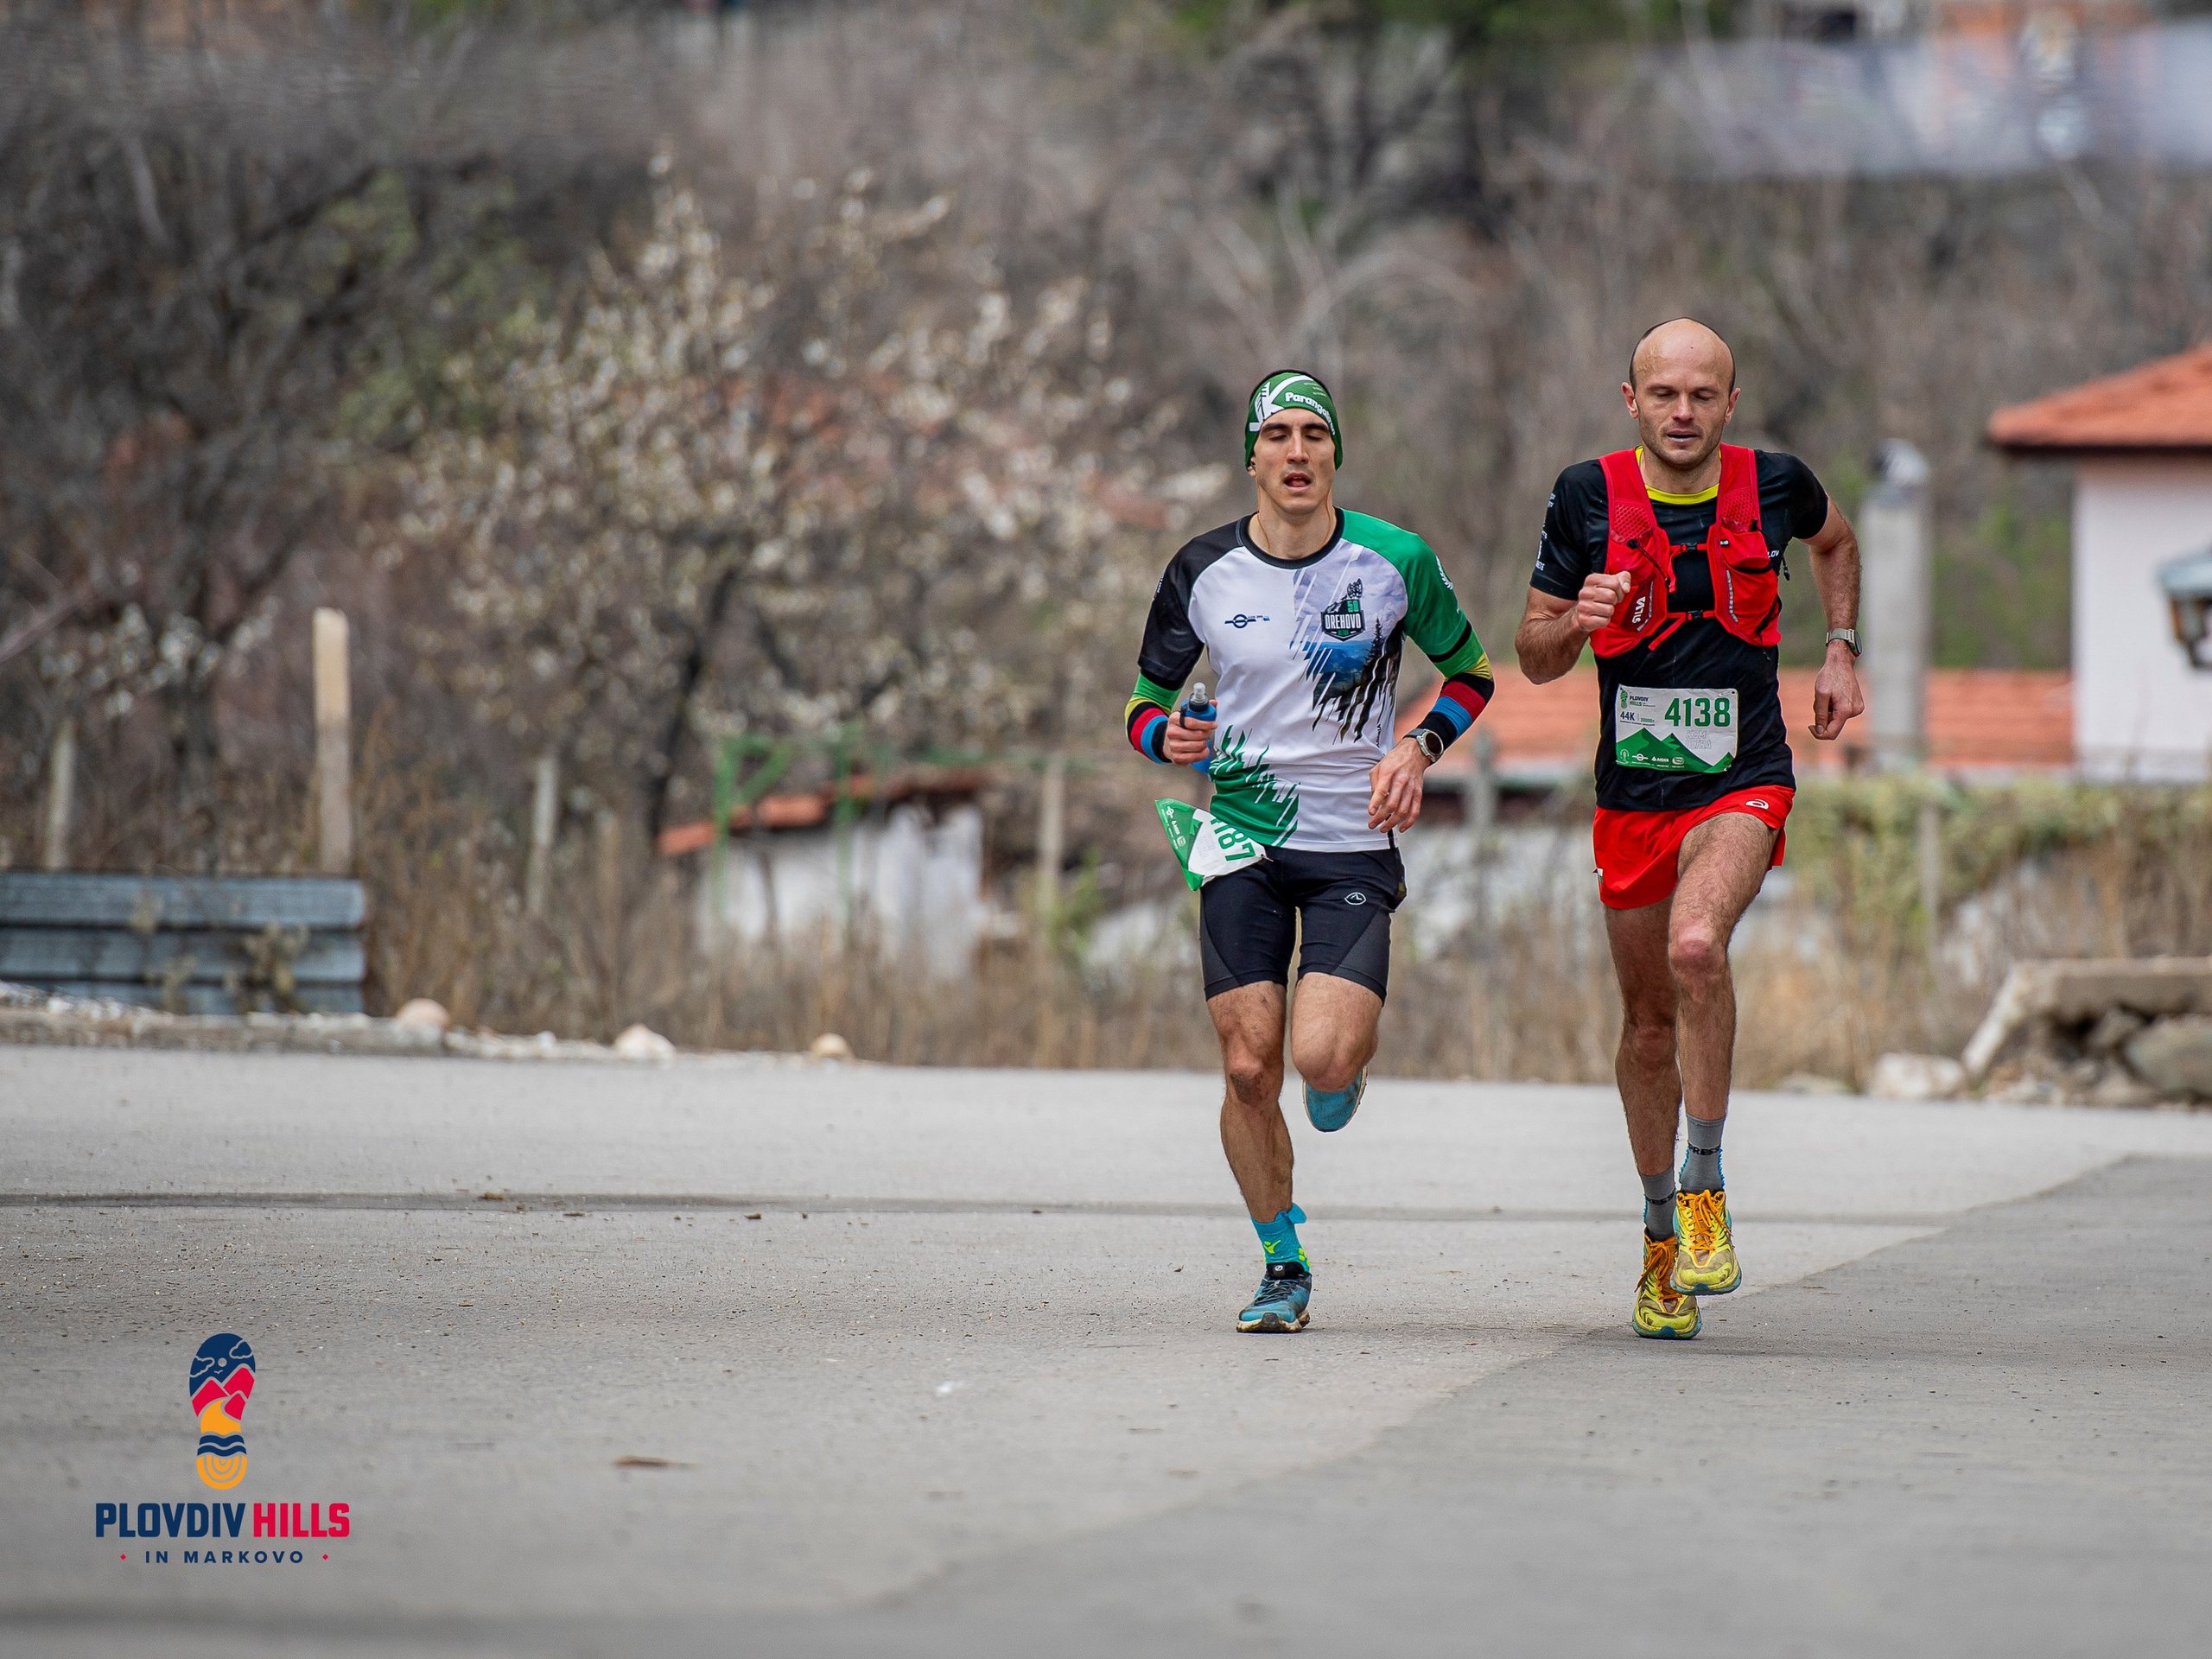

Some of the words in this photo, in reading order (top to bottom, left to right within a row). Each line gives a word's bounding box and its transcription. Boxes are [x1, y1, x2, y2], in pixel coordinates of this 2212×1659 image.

[1347, 600, 1360, 613] 50
[1631, 596, 1646, 624] SILVA
[1325, 613, 1362, 630] OREHOVO
[1619, 710, 1635, 721] 44K
[1664, 697, 1731, 728] 4138
[1686, 729, 1707, 740] KCM
[1686, 739, 1712, 749] ULTRA
